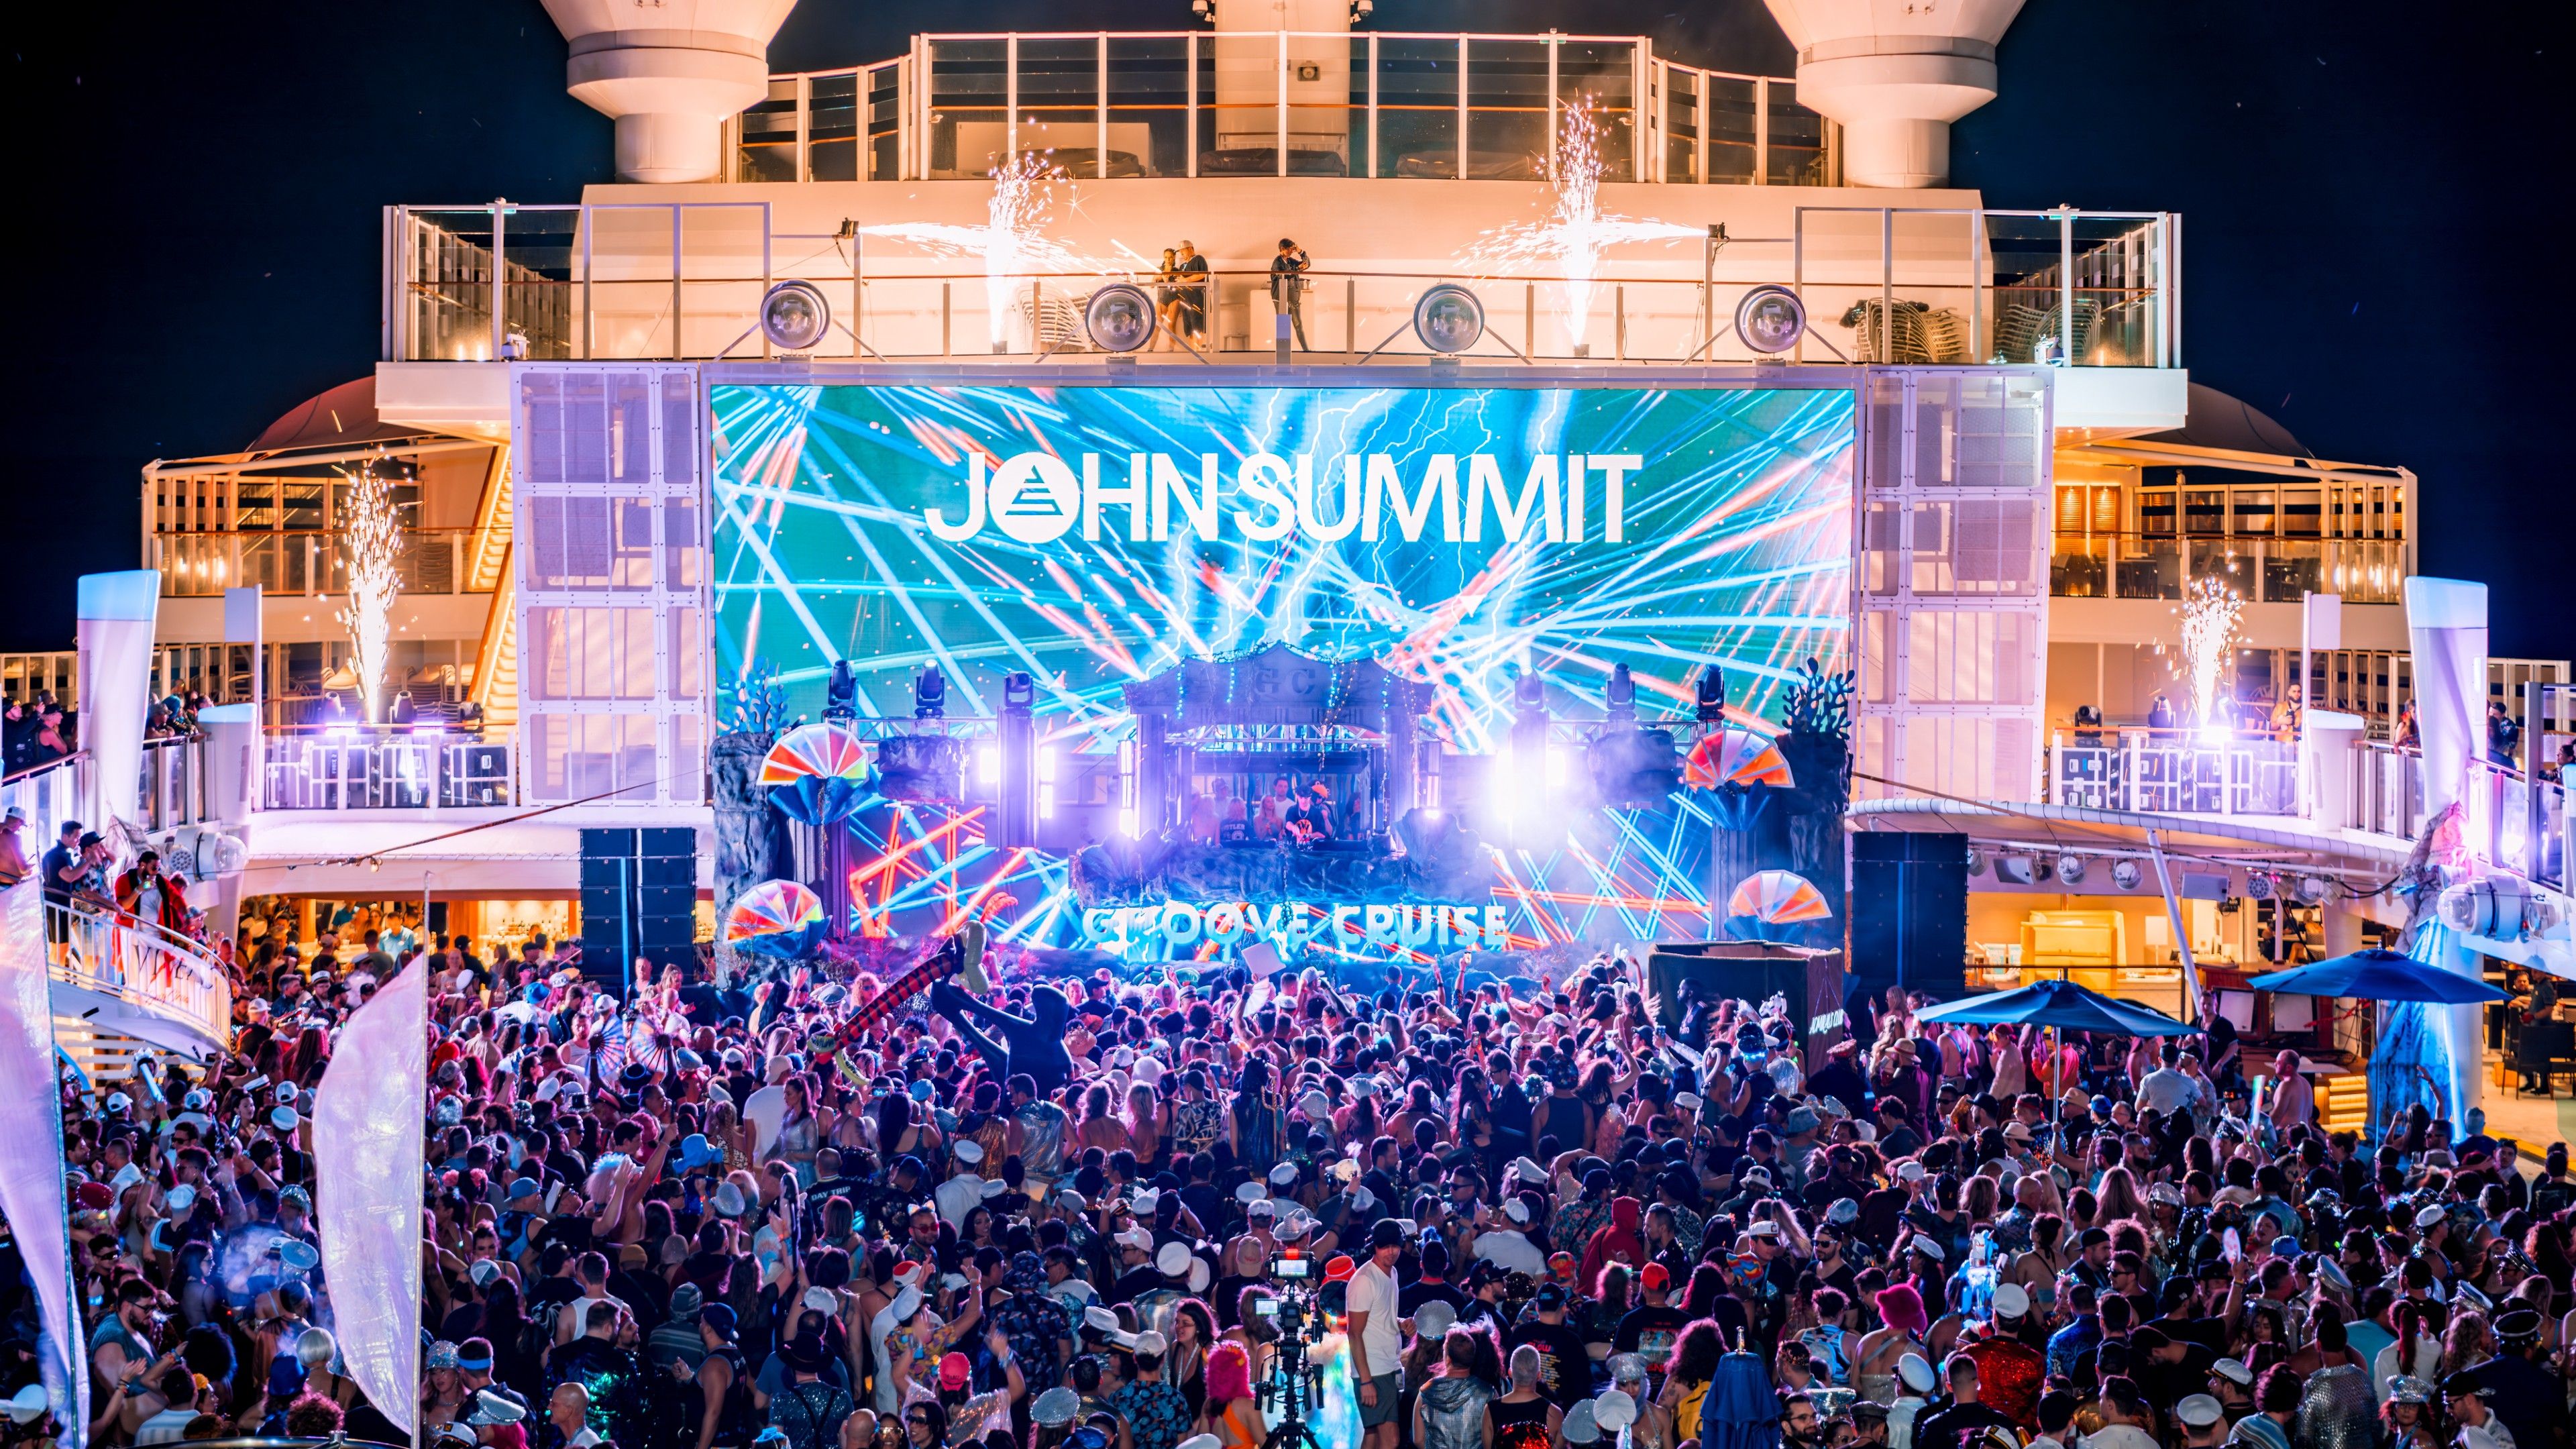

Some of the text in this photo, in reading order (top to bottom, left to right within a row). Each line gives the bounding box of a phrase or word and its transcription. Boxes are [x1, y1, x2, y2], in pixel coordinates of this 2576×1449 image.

[924, 452, 1643, 543] JOHN SUMMIT
[1082, 900, 1507, 945] GROOVE CRUISE
[811, 1185, 851, 1201] DAY TRIP
